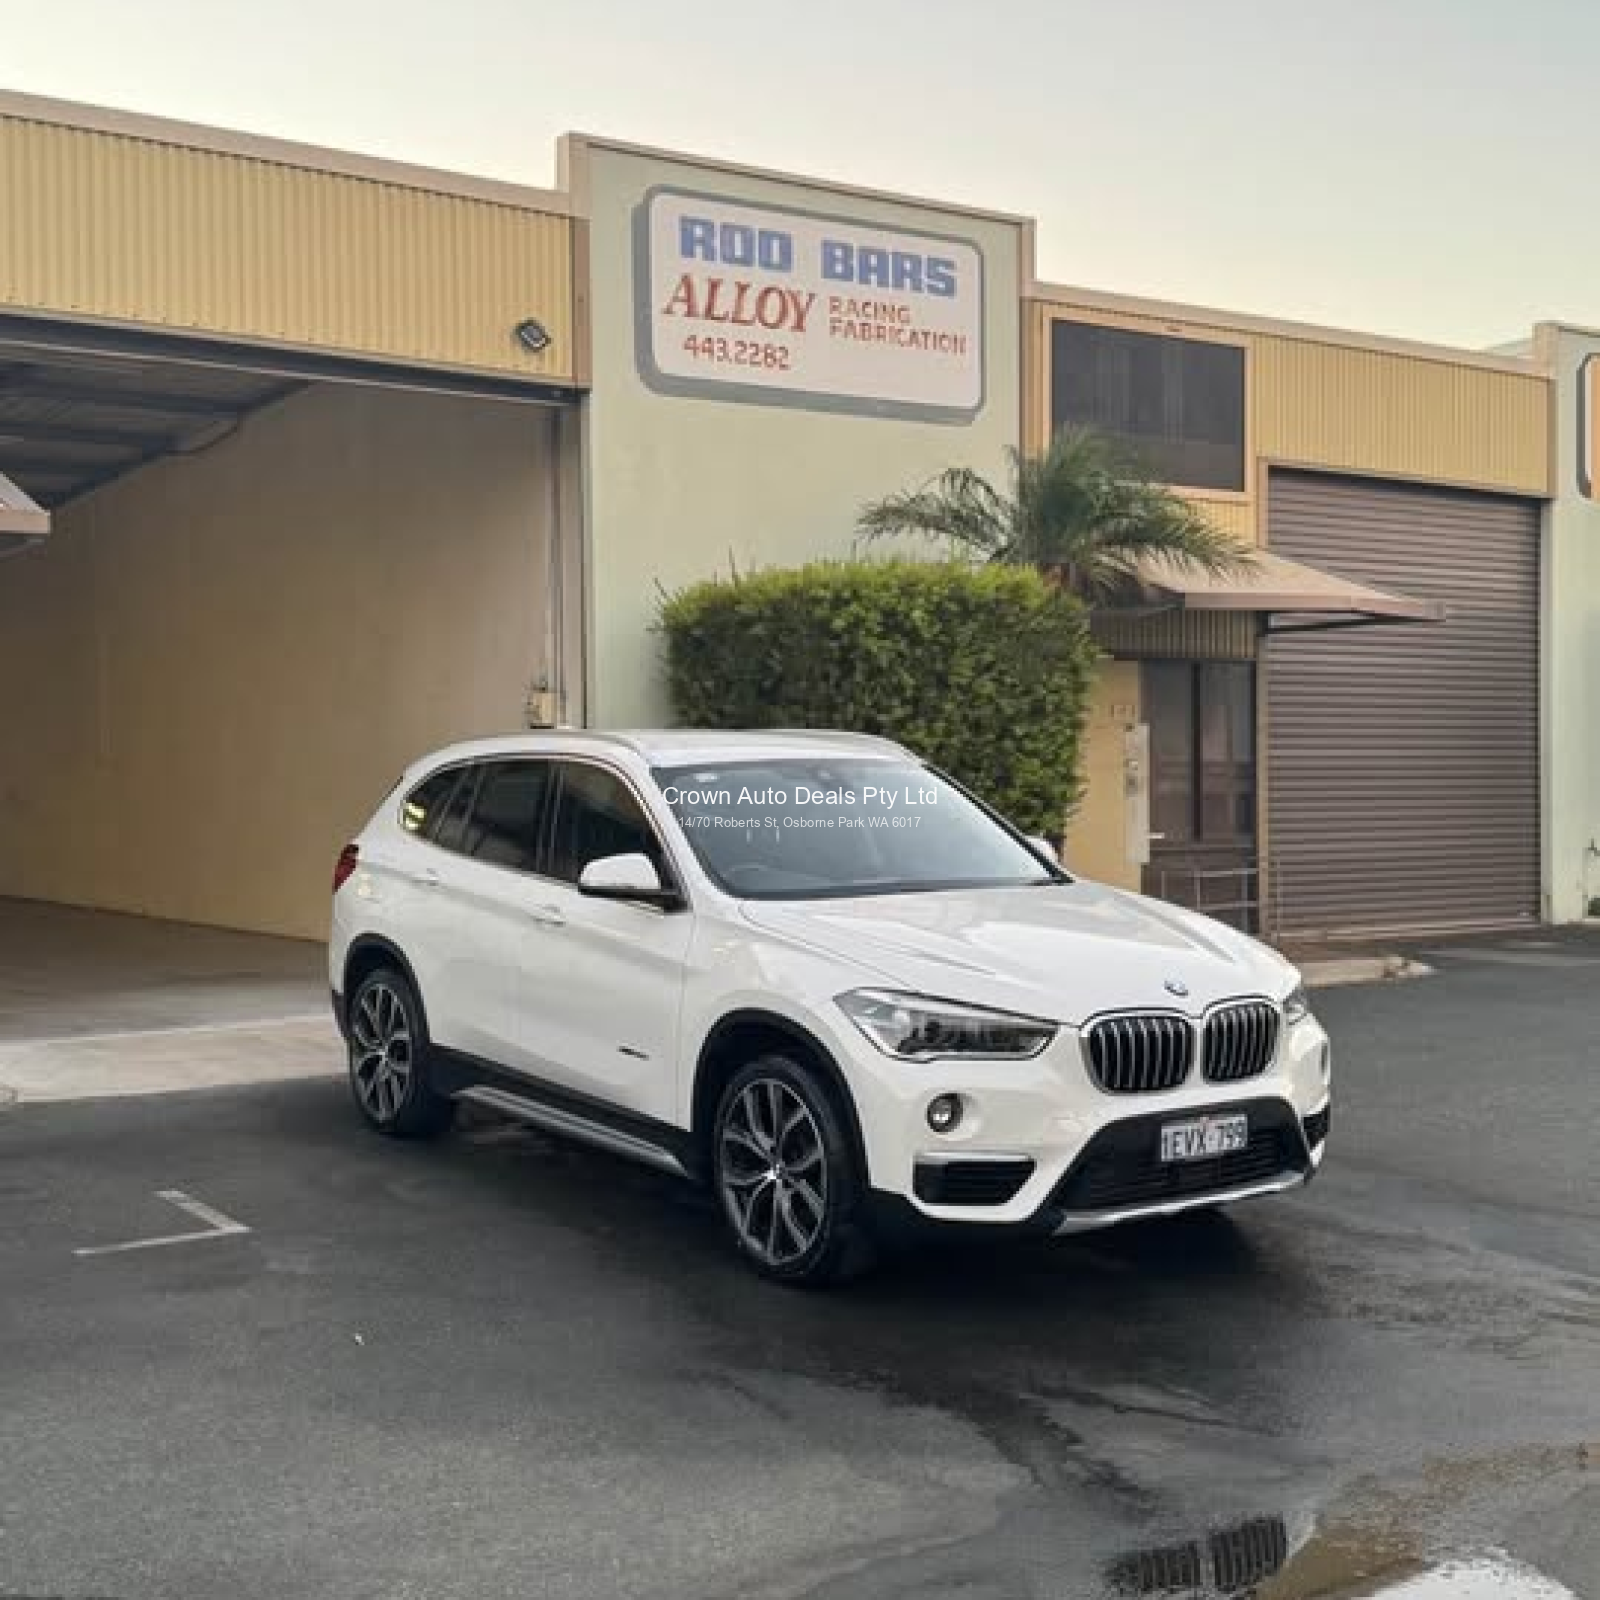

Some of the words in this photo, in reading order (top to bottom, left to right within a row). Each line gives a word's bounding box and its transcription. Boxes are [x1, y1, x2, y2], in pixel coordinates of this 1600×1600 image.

[821, 240, 956, 297] BARS
[663, 273, 817, 333] ALLOY
[828, 296, 910, 323] RACING
[829, 317, 967, 354] FABRICATION
